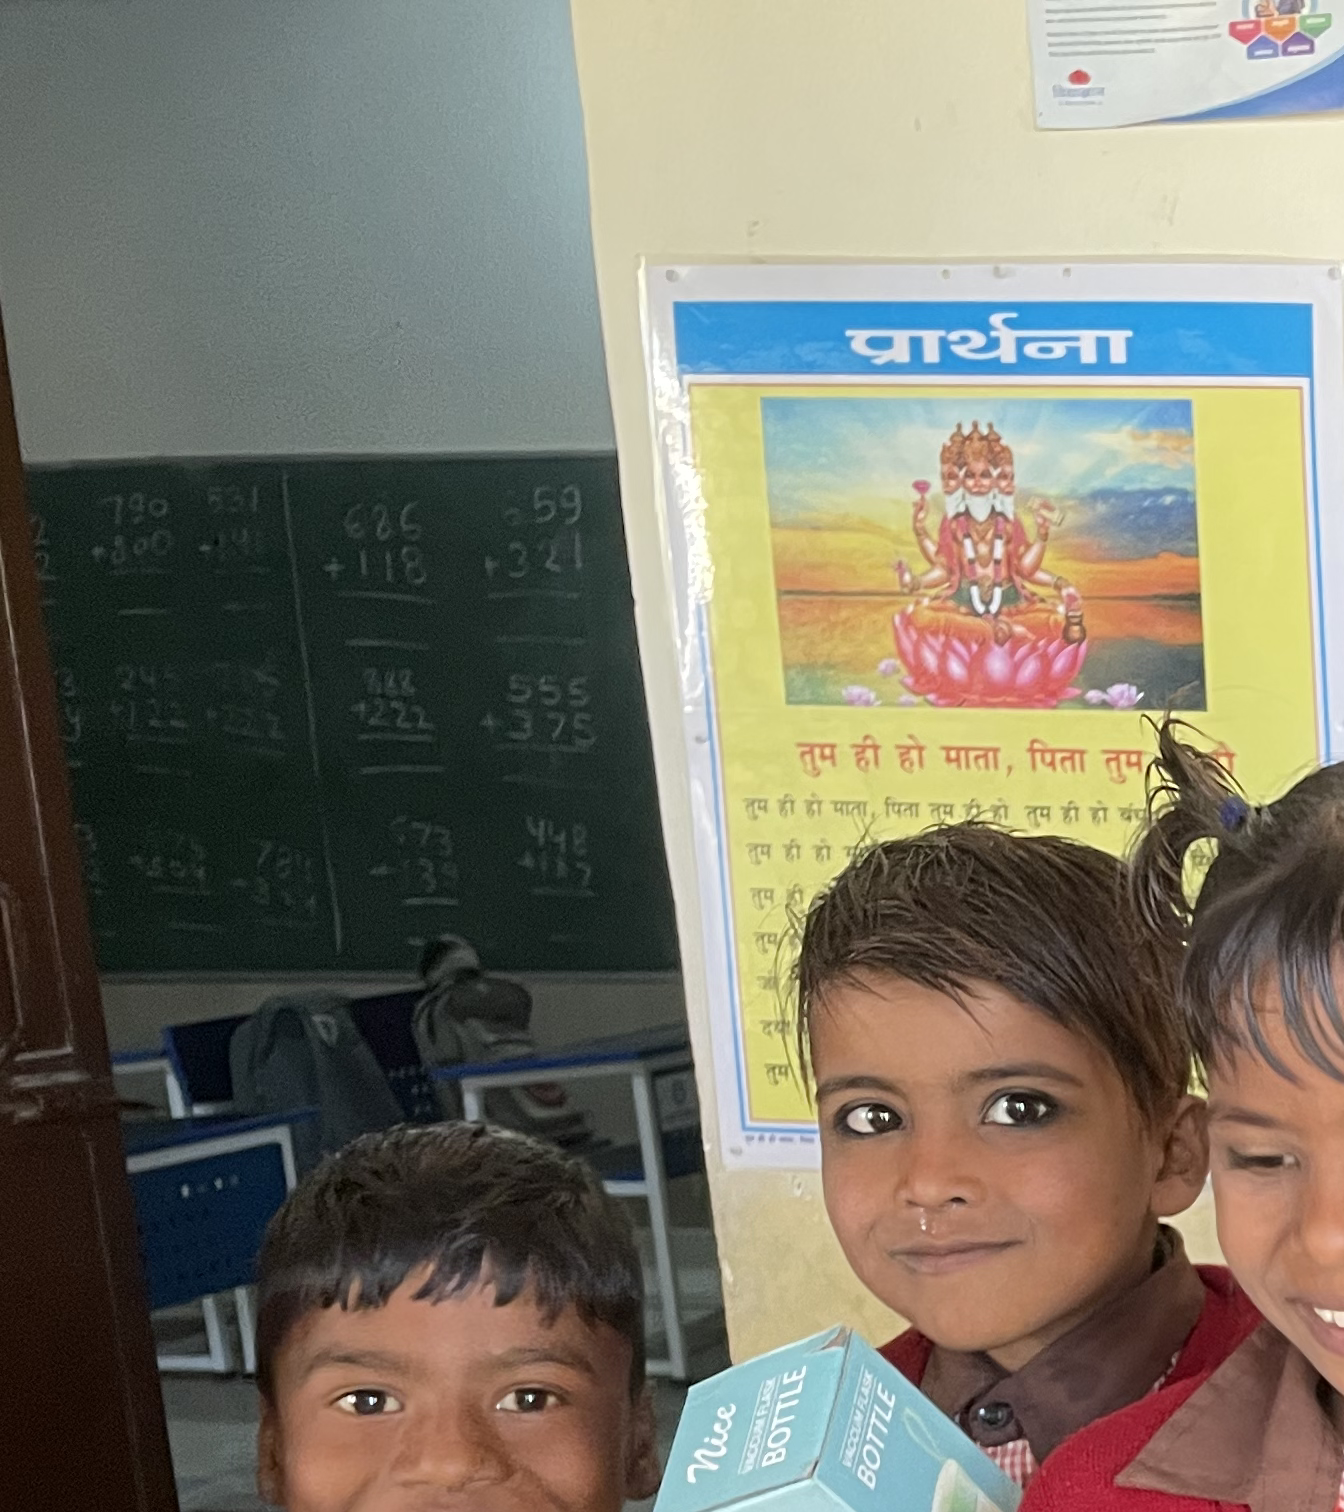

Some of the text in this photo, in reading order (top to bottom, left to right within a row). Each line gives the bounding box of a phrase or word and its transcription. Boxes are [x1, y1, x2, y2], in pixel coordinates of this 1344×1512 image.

[845, 312, 1133, 365] प्रार्थना
[796, 743, 837, 777] तुम
[850, 734, 881, 773] ही
[895, 733, 926, 773] हो
[1026, 738, 1088, 773] पिता
[1101, 749, 1145, 784] तुम
[743, 797, 769, 820] तुम
[777, 793, 797, 817] ही
[804, 792, 823, 817] हो
[885, 796, 919, 818] पिता
[1024, 804, 1050, 828] तुम
[1060, 800, 1080, 825] ही
[1089, 800, 1109, 825] हो
[747, 843, 771, 865] तुम
[783, 838, 802, 863] ही
[813, 838, 831, 862] हो
[750, 888, 774, 909] तुम
[764, 1063, 789, 1085] तुम
[761, 1365, 807, 1468] BOTTLE
[857, 1382, 896, 1491] BOTTLE
[687, 1403, 737, 1484] Nice
